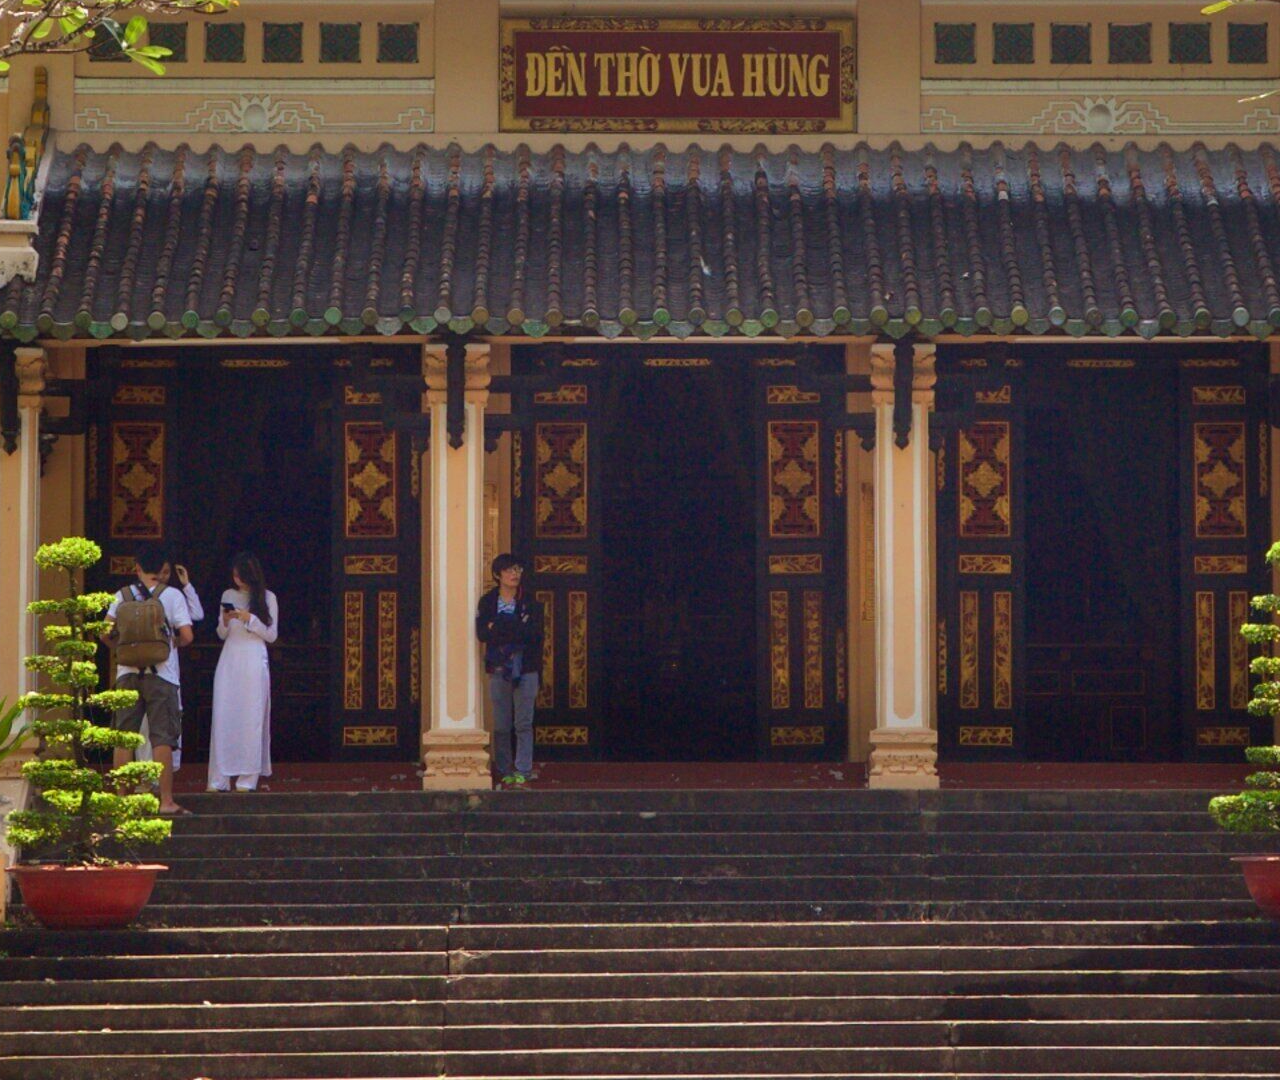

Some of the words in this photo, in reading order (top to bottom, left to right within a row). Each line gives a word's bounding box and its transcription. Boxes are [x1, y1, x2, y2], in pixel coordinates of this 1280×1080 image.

[525, 44, 587, 97] ĐỀN
[594, 46, 661, 97] THỜ
[669, 53, 735, 97] VUA
[742, 46, 830, 97] HÙNG
